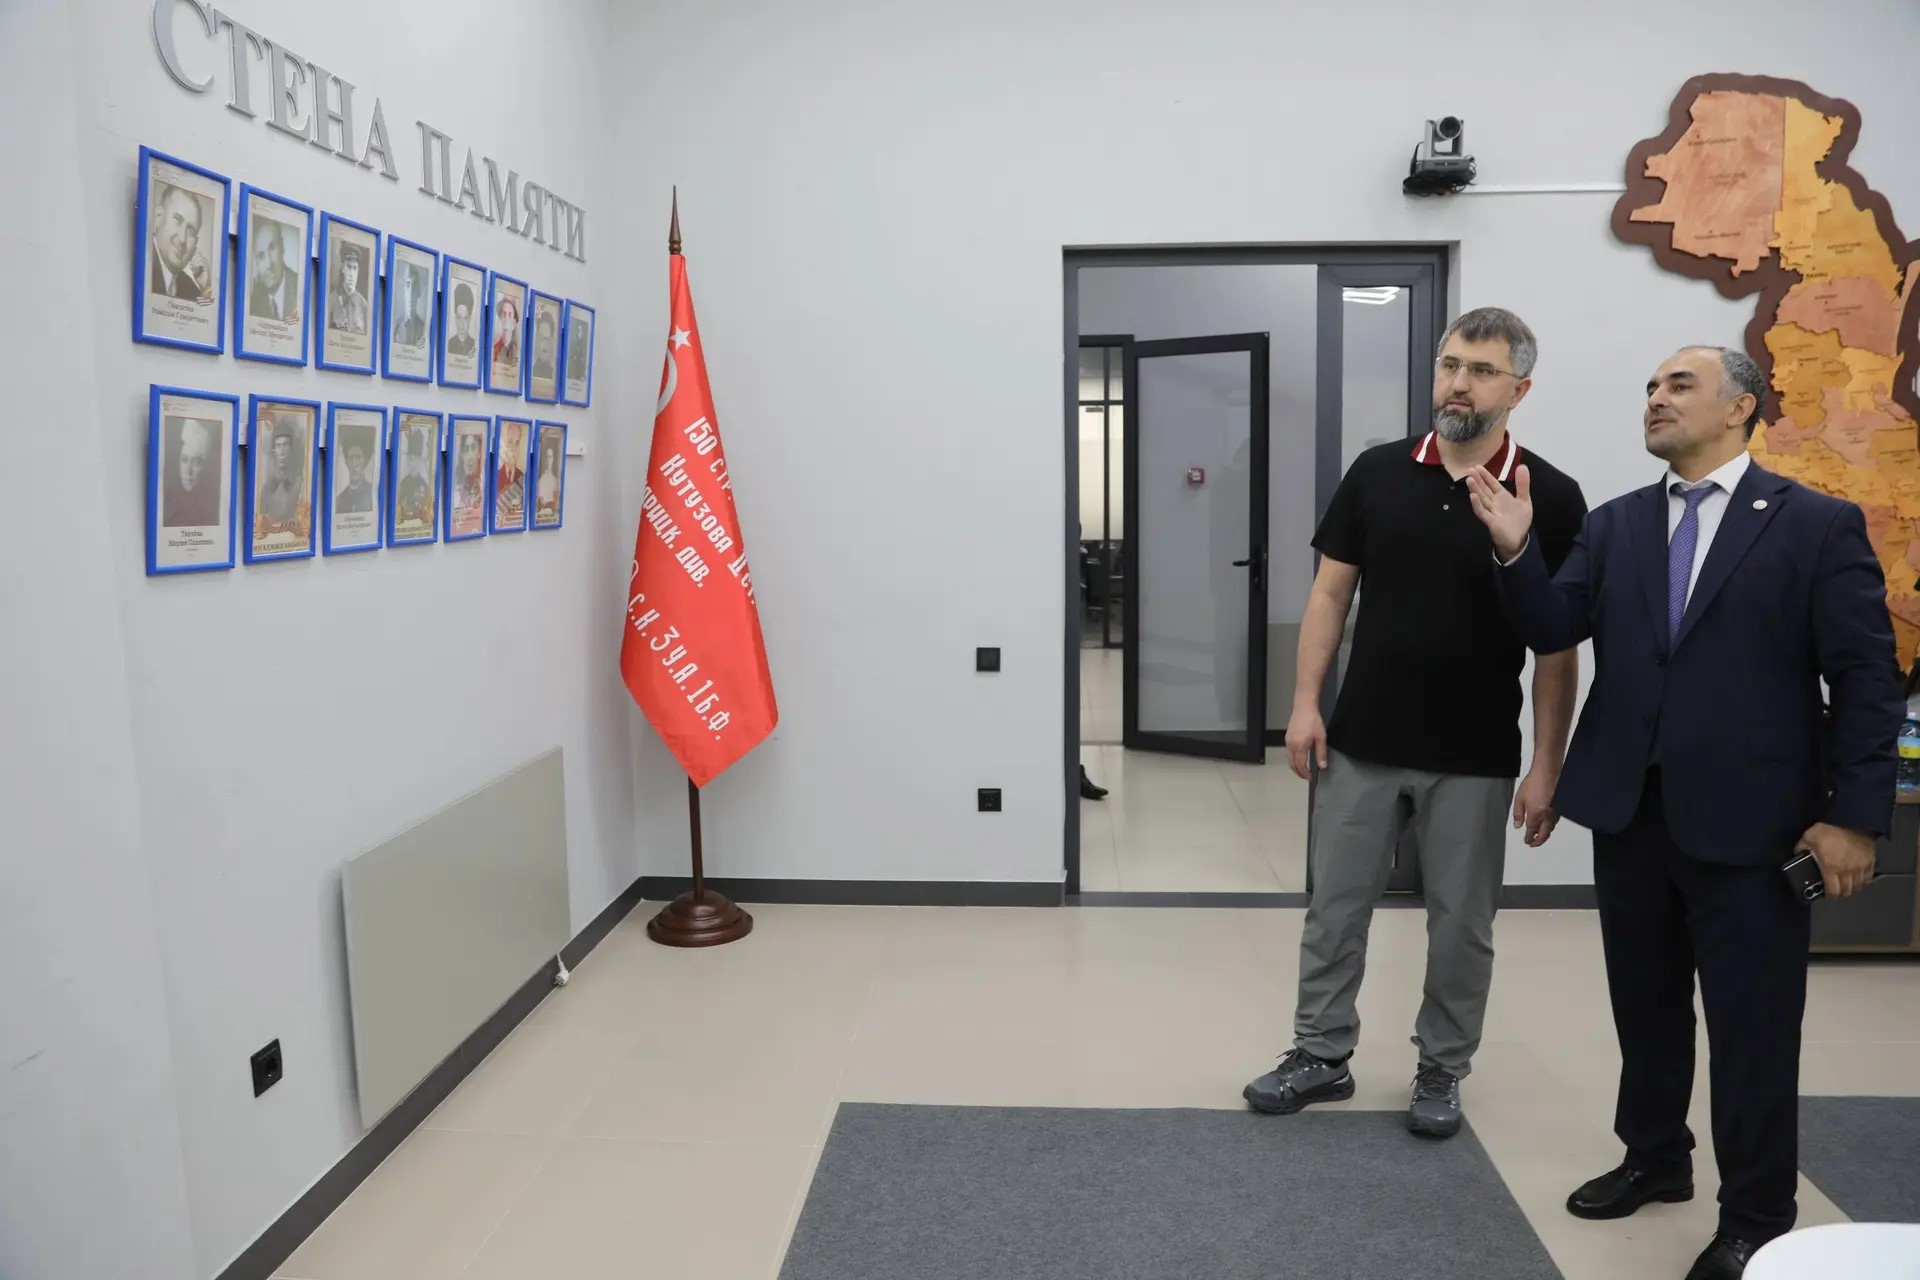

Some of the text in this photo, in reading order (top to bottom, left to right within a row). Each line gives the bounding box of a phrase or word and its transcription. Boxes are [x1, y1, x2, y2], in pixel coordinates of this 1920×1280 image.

[150, 0, 588, 263] СТЕНА ПАМЯТИ
[684, 416, 718, 456] 150
